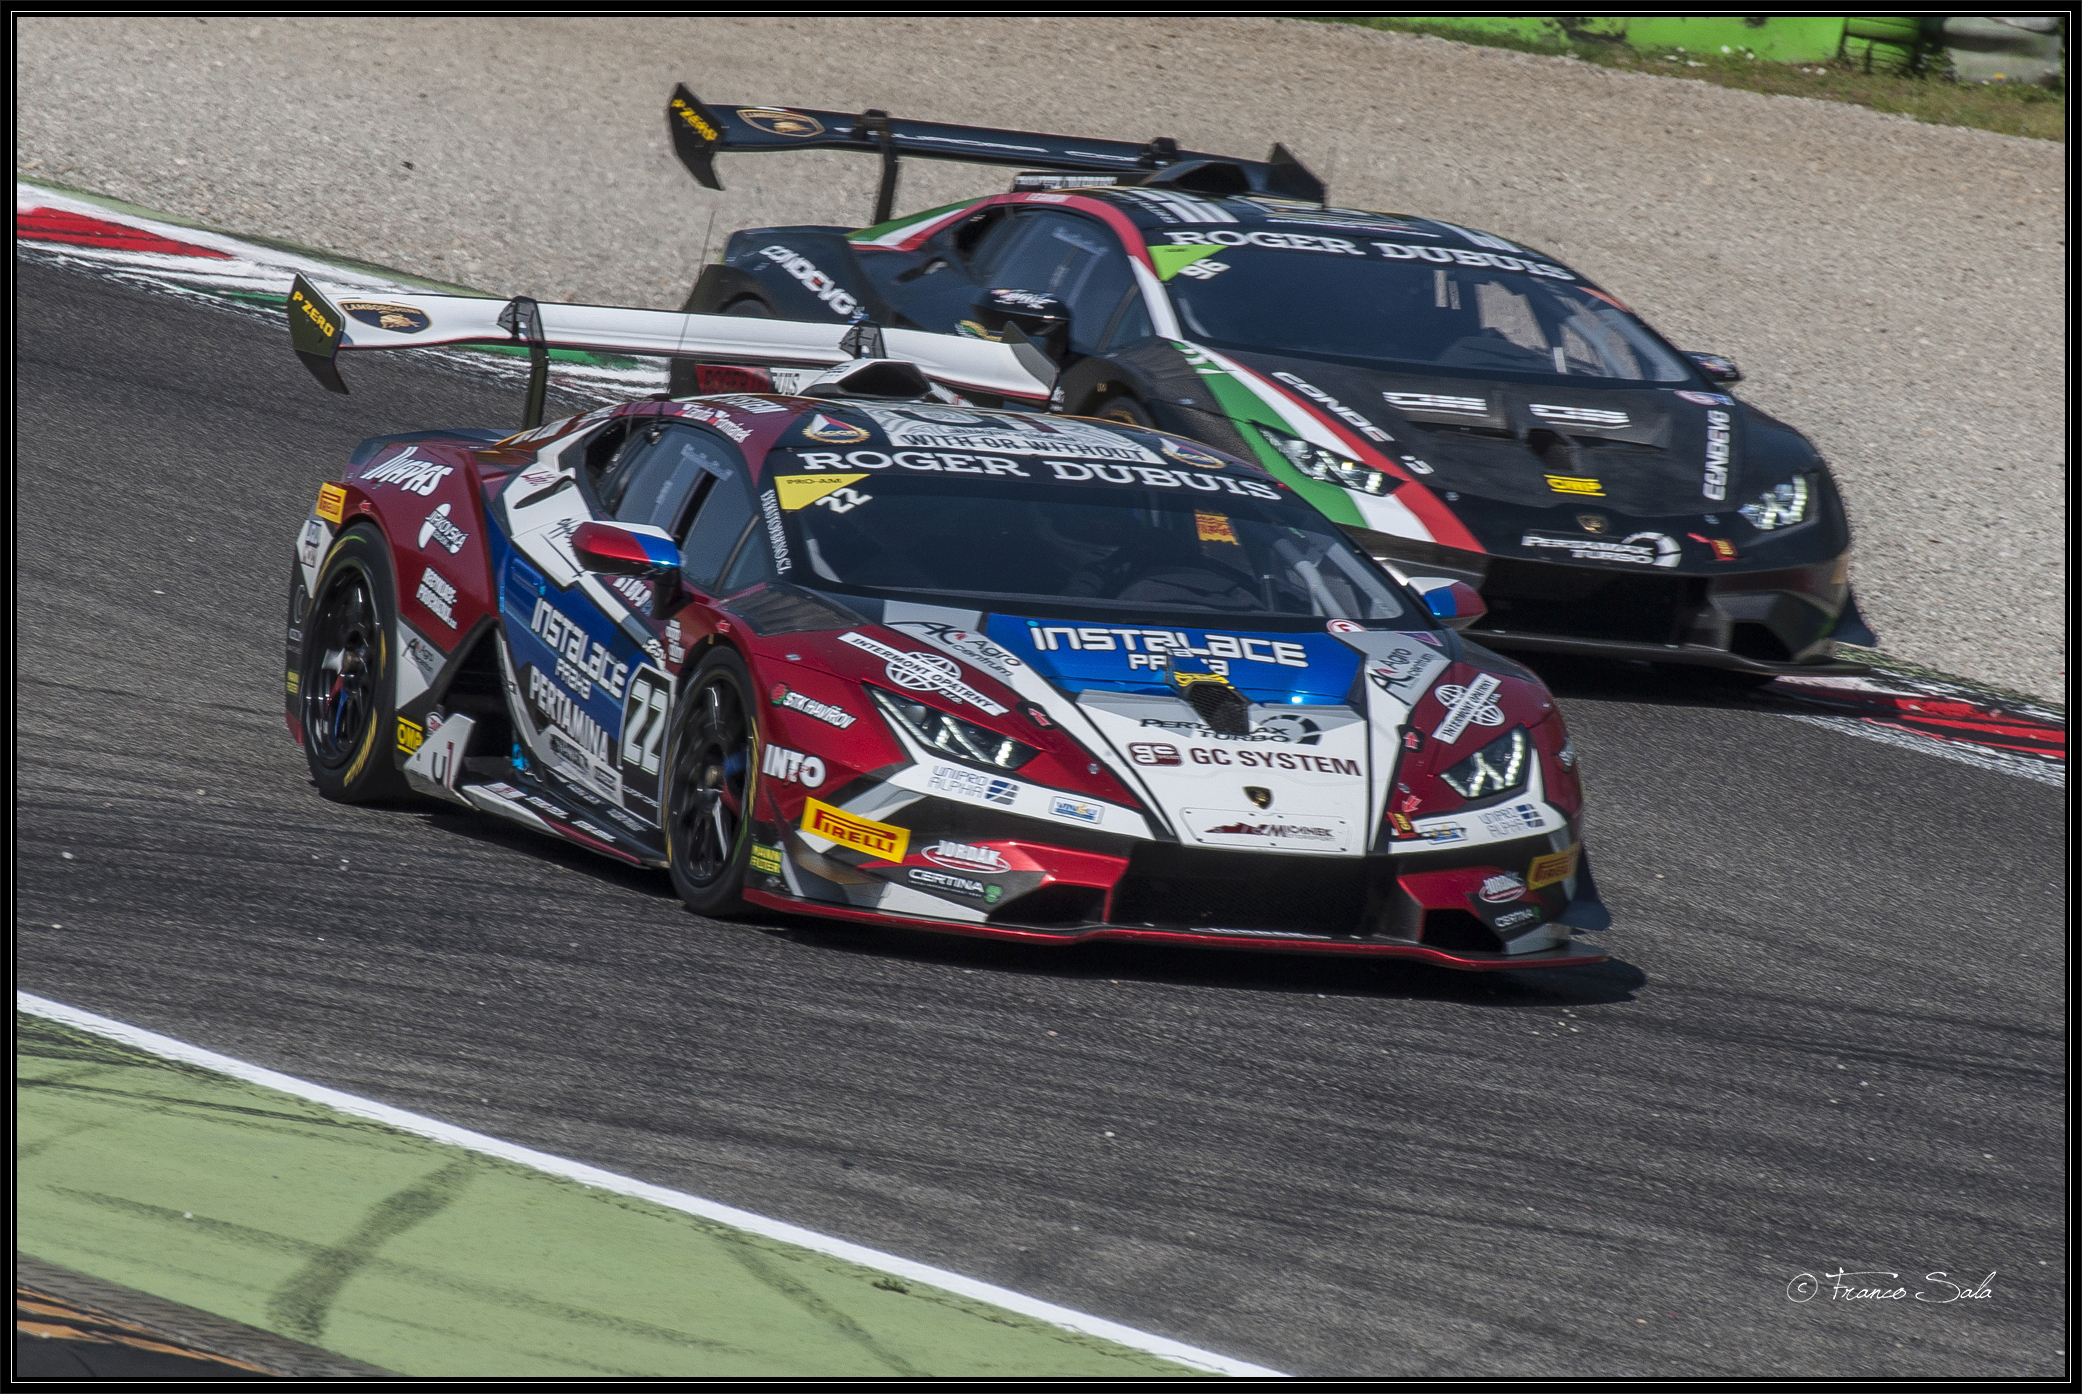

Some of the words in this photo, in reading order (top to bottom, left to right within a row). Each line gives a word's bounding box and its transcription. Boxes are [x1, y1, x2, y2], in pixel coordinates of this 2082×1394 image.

[680, 107, 718, 141] ZERO
[1163, 230, 1367, 256] ROGER
[1371, 242, 1576, 281] DUBUIS
[292, 290, 304, 302] P
[301, 299, 335, 338] ZERO
[901, 433, 976, 449] WITH
[981, 436, 1020, 451] OR
[1023, 440, 1146, 462] WITHOUT
[786, 477, 843, 486] PRO-AM
[797, 450, 1031, 478] ROGER
[1043, 459, 1283, 501] DUBUIS
[1546, 476, 1603, 493] OMP
[815, 487, 874, 514] 22
[1569, 547, 1655, 565] TURBO
[852, 638, 933, 676] INTERMONT
[951, 643, 1014, 678] centrum
[963, 638, 1022, 667] Agro
[1379, 647, 1414, 671] Agro
[529, 665, 610, 767] PERTAMINA
[621, 677, 669, 776] 22
[397, 722, 424, 751] OMP
[1199, 730, 1291, 743] TURBO
[932, 765, 988, 786] UNIPRO
[1188, 747, 1232, 767] GC
[1236, 750, 1364, 777] SYSTEM
[926, 776, 985, 800] ALPHA
[813, 808, 898, 854] PIRELLI
[751, 856, 781, 874] FILTER
[752, 843, 782, 863] MANN
[908, 868, 985, 893] CERTINA
